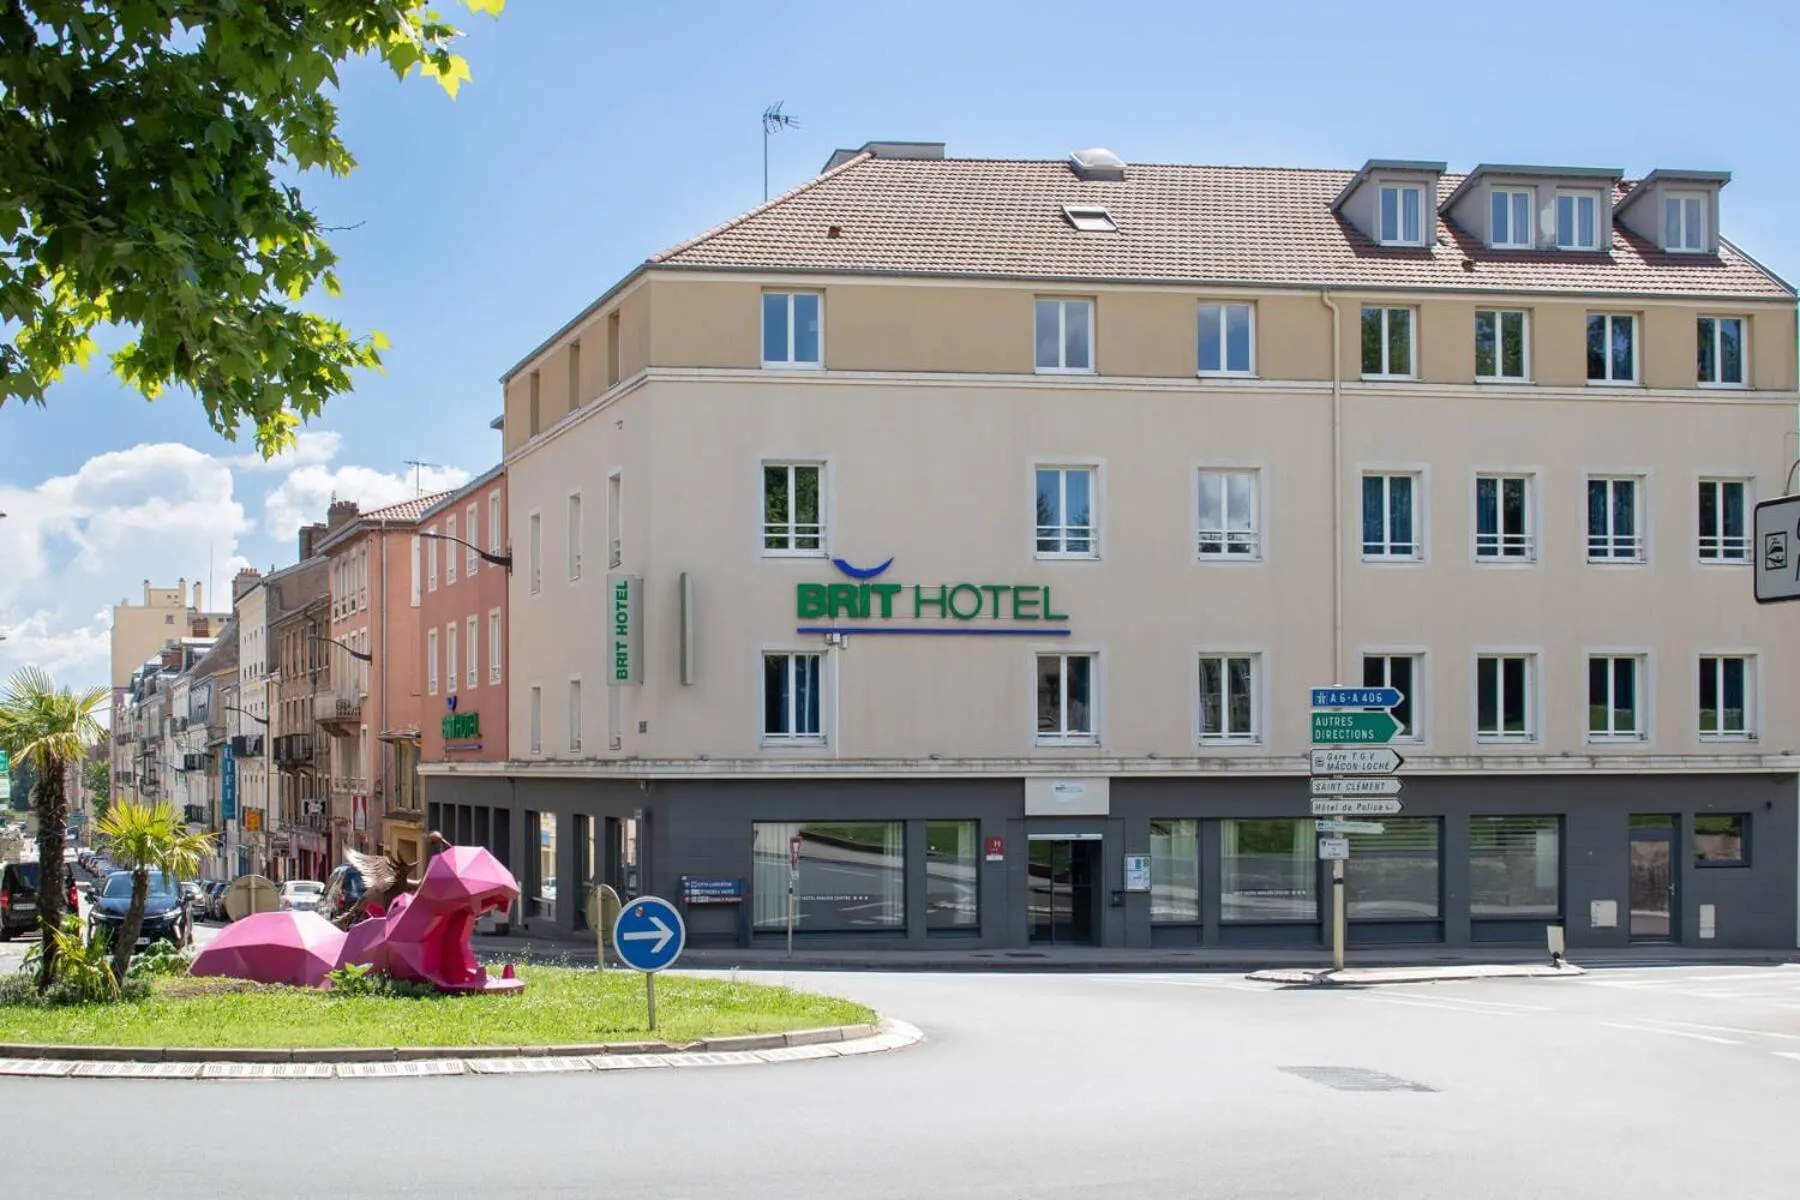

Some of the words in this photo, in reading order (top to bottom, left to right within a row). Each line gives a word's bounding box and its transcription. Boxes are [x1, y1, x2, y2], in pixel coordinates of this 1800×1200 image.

[797, 583, 901, 619] BRIT
[914, 583, 1069, 620] HOTEL
[616, 580, 628, 636] HOTEL
[616, 641, 628, 680] BRIT
[1315, 716, 1353, 726] AUTRES
[1315, 729, 1374, 739] DIRECTIONS
[1327, 752, 1346, 760] Gare
[1315, 782, 1341, 791] SAINT
[1342, 803, 1352, 811] de
[1356, 803, 1383, 811] Police
